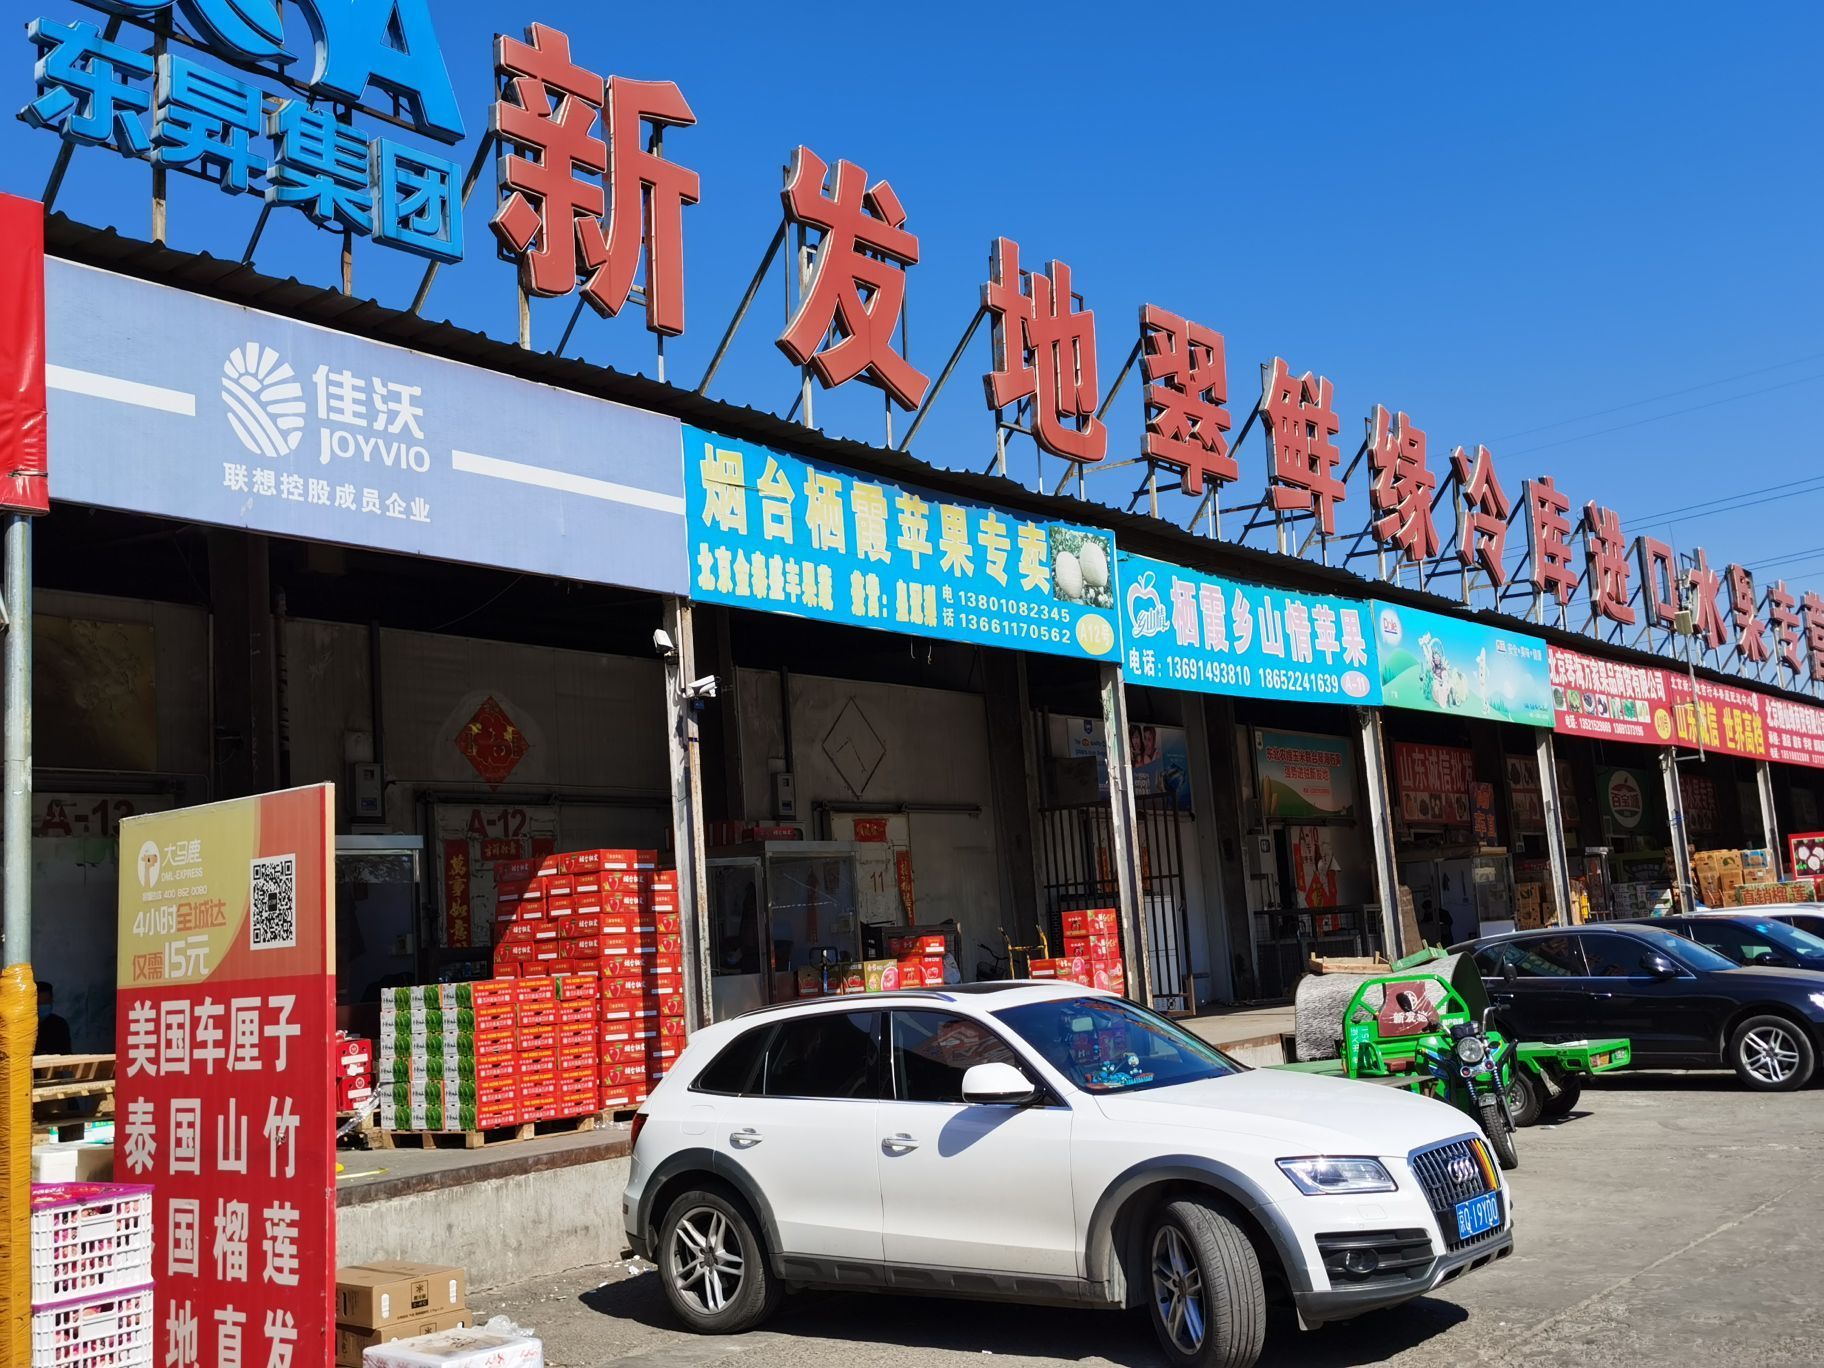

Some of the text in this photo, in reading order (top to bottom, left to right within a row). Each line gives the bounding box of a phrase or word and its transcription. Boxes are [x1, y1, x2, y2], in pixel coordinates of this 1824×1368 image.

[20, 17, 464, 263] 东昇集团
[311, 364, 425, 441] 佳沃
[319, 428, 431, 473] JOYVIO
[222, 461, 432, 525] 联想控股成员企业
[700, 442, 1051, 595] 烟台栖霞苹果专卖
[958, 590, 1071, 624] 13801082345
[960, 613, 1072, 645] 13661170562
[1170, 575, 1368, 668] 栖霞乡山情苹果
[1258, 668, 1339, 694] 18652241639
[468, 808, 528, 839] A-12
[161, 839, 202, 876] 大马鹿
[133, 898, 227, 938] 4小时全城达
[132, 934, 210, 982] 仅需15元
[126, 994, 301, 1078] 美国车厘子
[124, 1095, 300, 1178] 泰国山竹
[151, 1198, 300, 1287] 国榴莲
